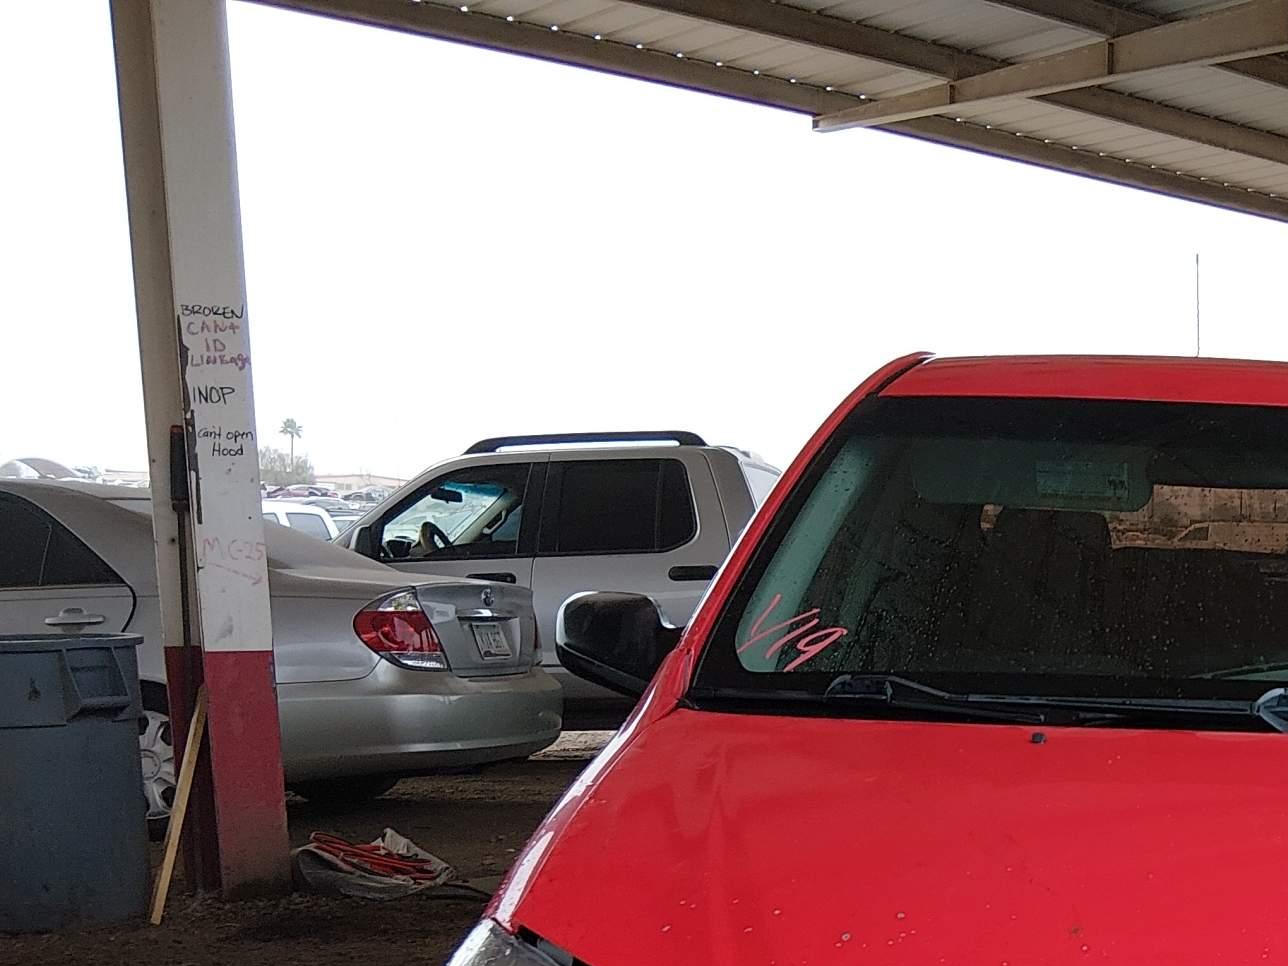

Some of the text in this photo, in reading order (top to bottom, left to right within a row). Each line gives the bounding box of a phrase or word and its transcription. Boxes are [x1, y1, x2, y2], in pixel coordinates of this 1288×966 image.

[180, 304, 244, 319] BROKEN
[205, 338, 226, 353] ID
[193, 384, 235, 405] INOP
[226, 430, 254, 444] open
[212, 441, 244, 456] Hood
